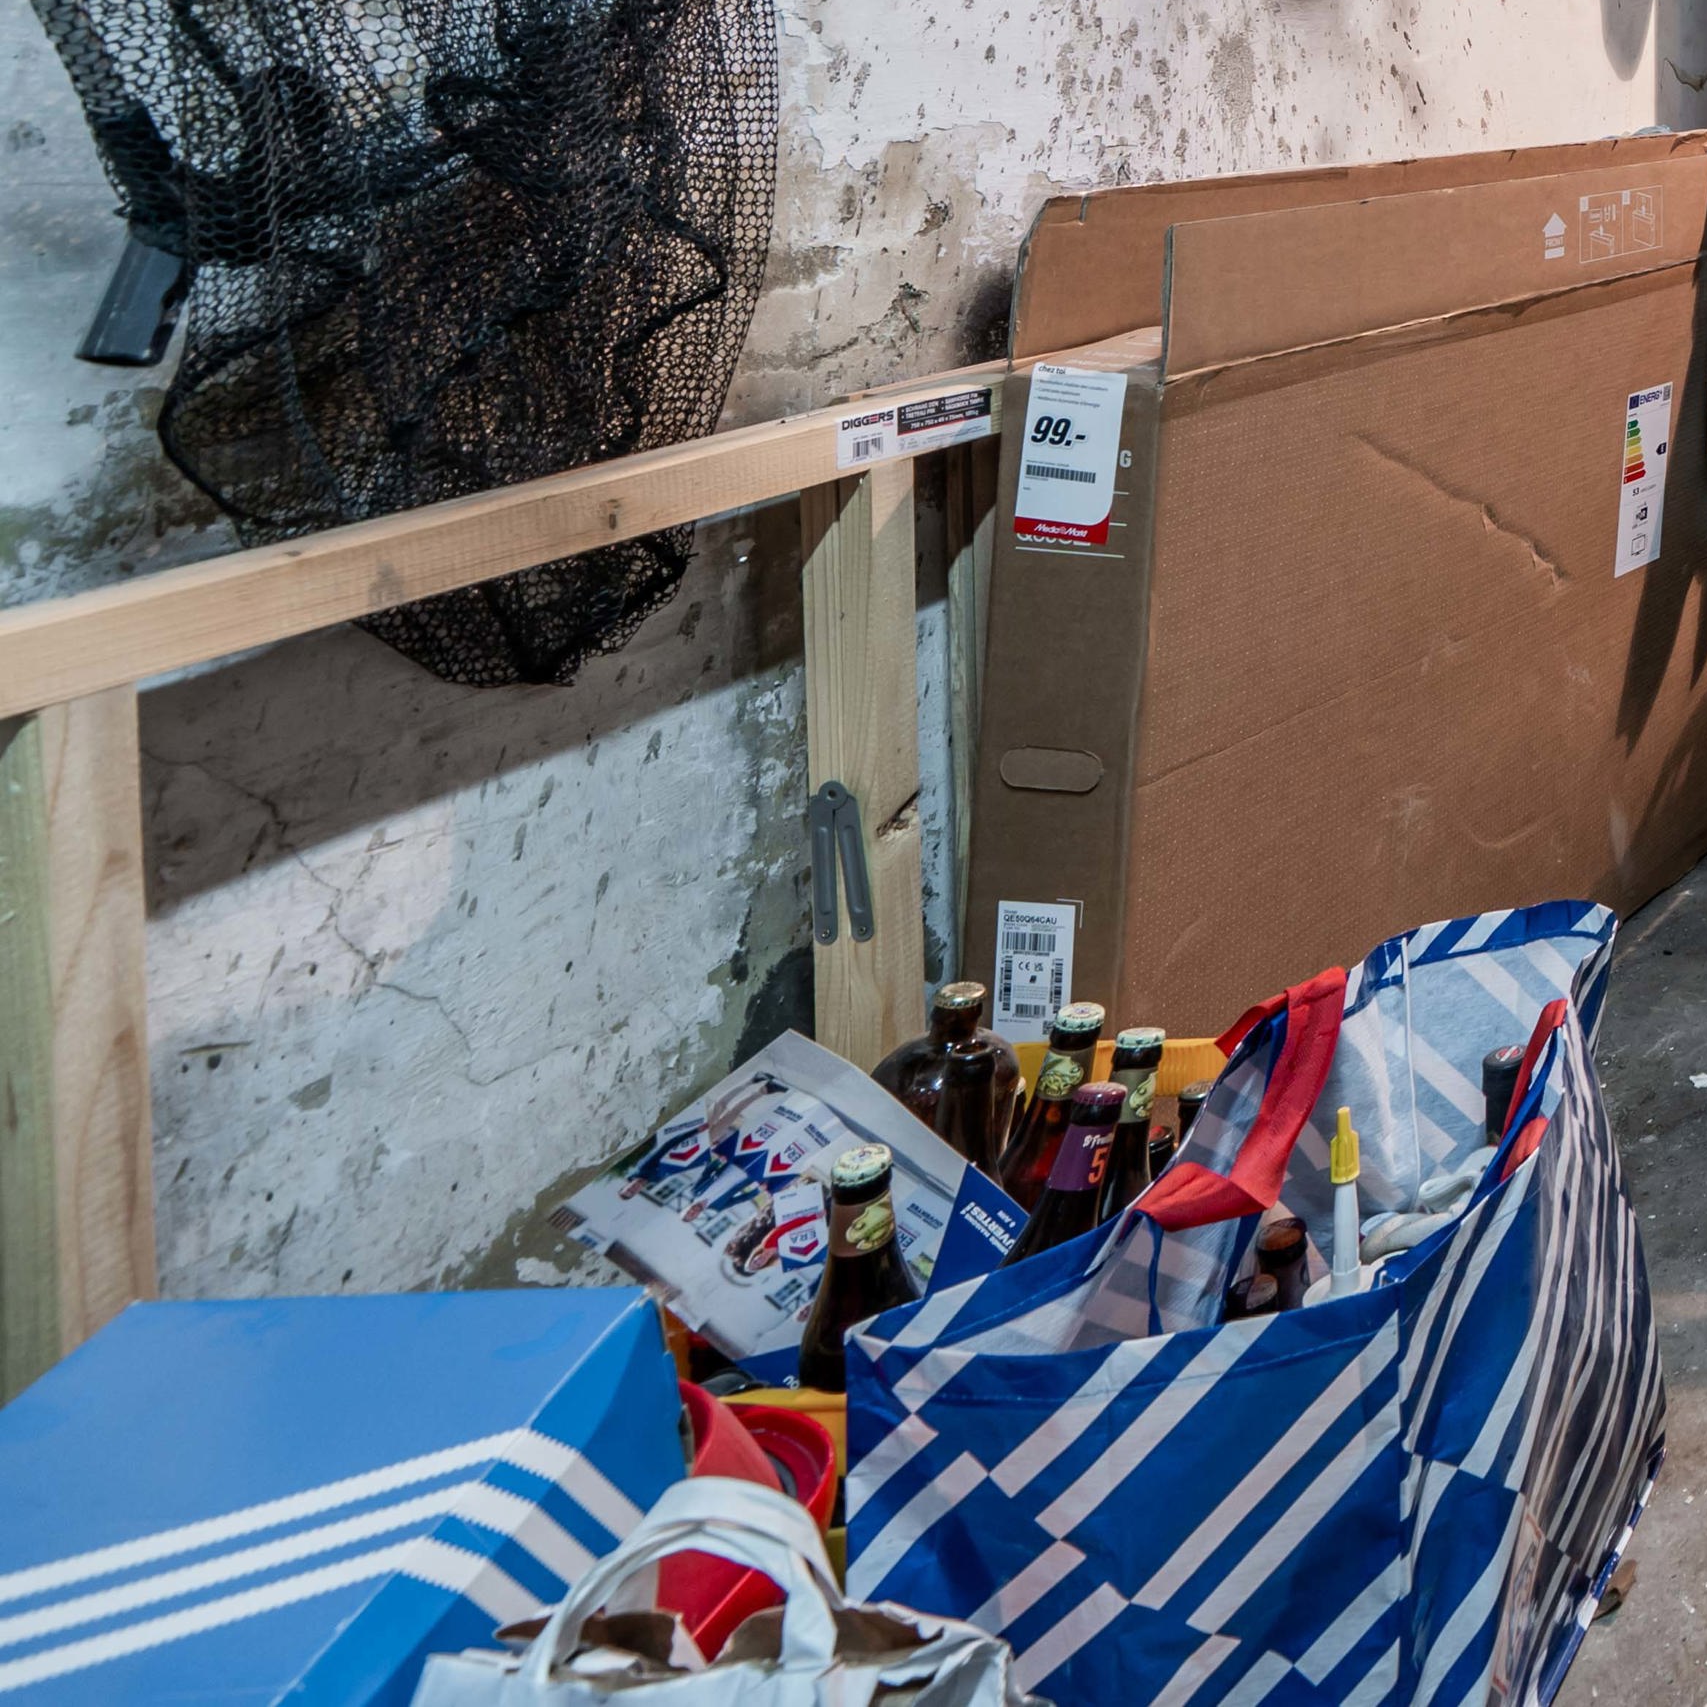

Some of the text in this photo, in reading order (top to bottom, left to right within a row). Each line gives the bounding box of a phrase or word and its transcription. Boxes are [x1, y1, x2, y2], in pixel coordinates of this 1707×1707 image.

[1038, 365, 1054, 375] chez
[841, 409, 895, 431] DIGGERS
[1030, 415, 1087, 447] 99.-
[789, 1228, 817, 1245] ERA
[959, 1201, 1017, 1251] UVERTES!
